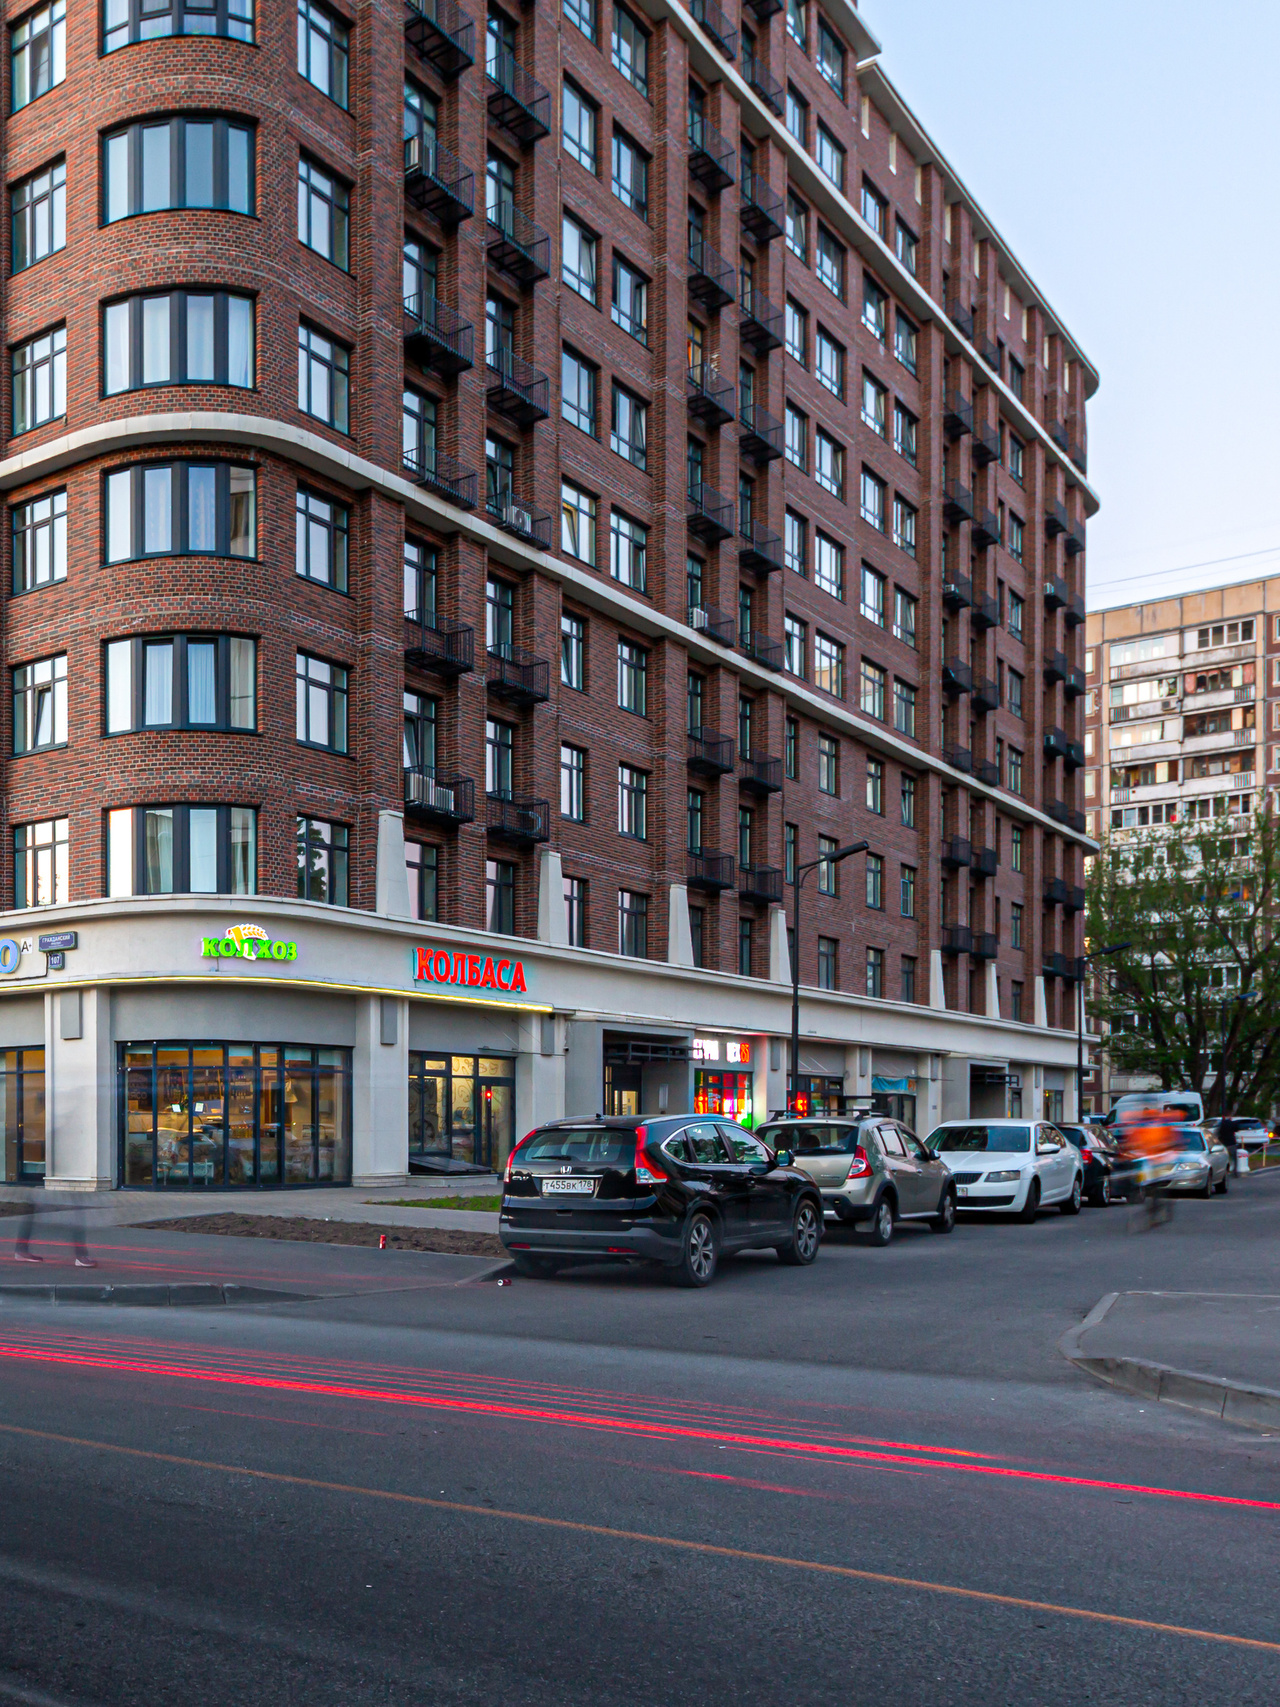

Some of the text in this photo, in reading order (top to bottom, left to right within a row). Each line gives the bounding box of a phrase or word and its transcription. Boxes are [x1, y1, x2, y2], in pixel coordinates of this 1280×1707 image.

[50, 956, 60, 964] 107
[202, 936, 297, 960] КОЛХОЗ
[416, 947, 527, 993] КОЛБАСА
